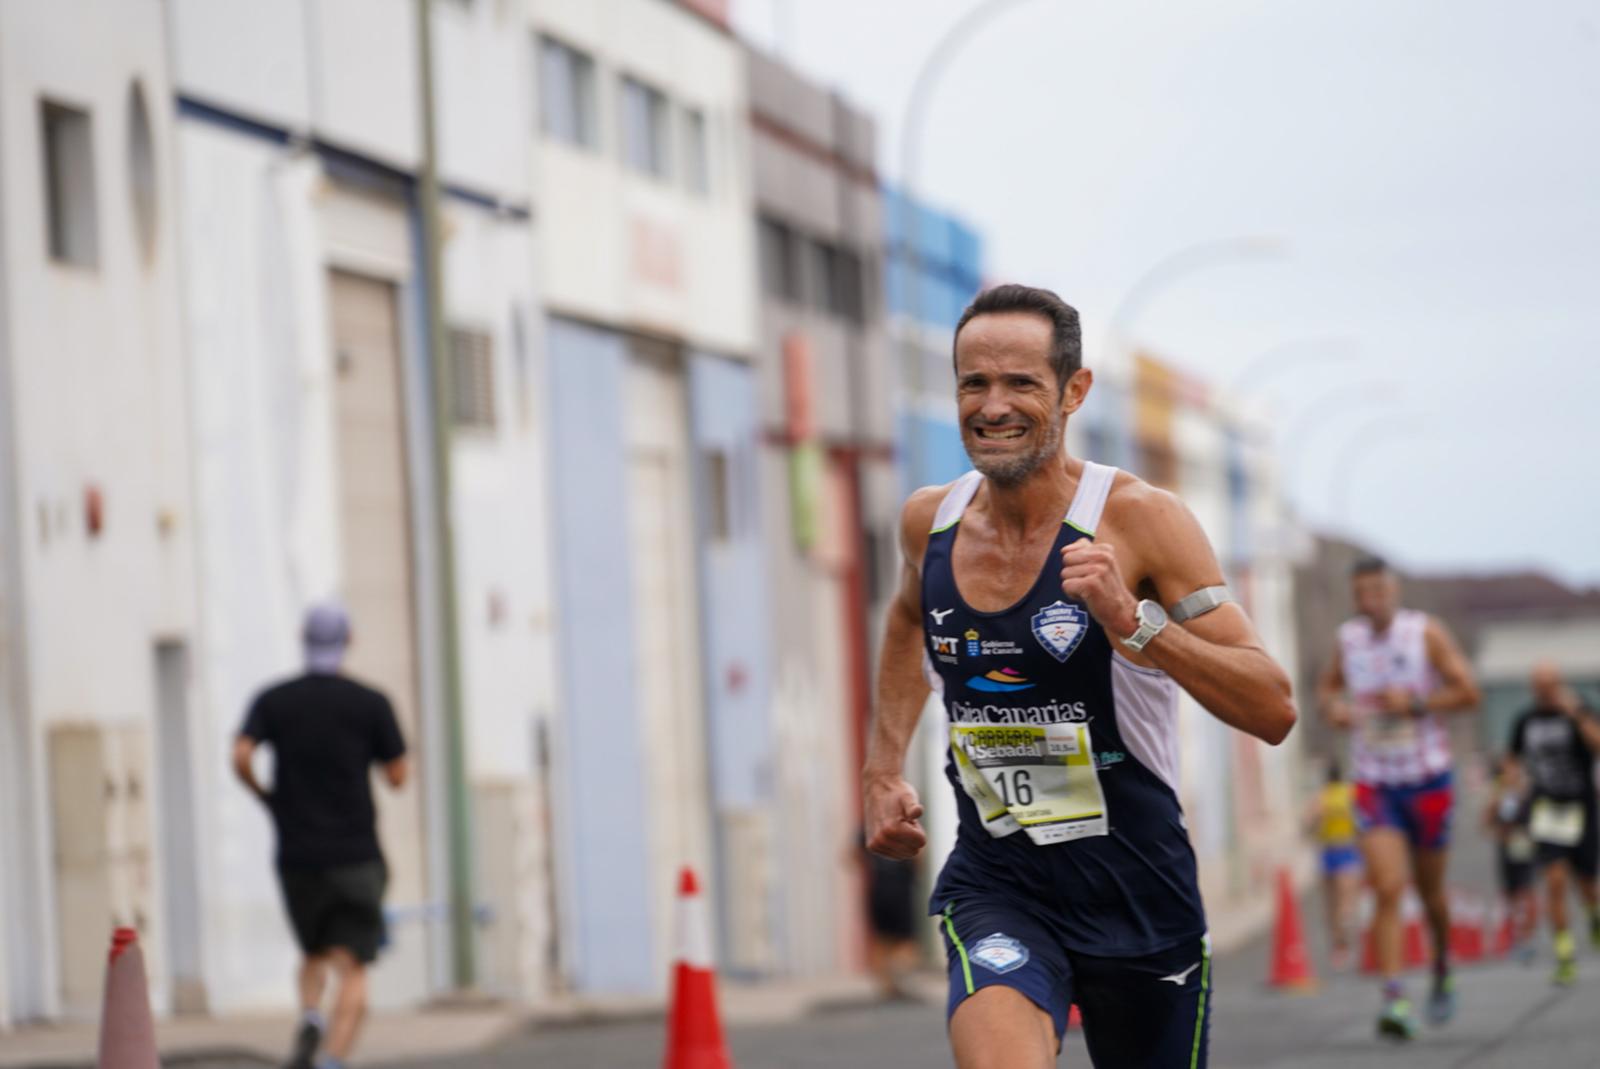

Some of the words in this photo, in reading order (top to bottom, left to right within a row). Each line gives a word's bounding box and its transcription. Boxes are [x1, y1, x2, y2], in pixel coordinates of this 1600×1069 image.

[981, 640, 1016, 648] Gobierno
[992, 647, 1024, 655] Canarias
[994, 769, 1033, 806] 16
